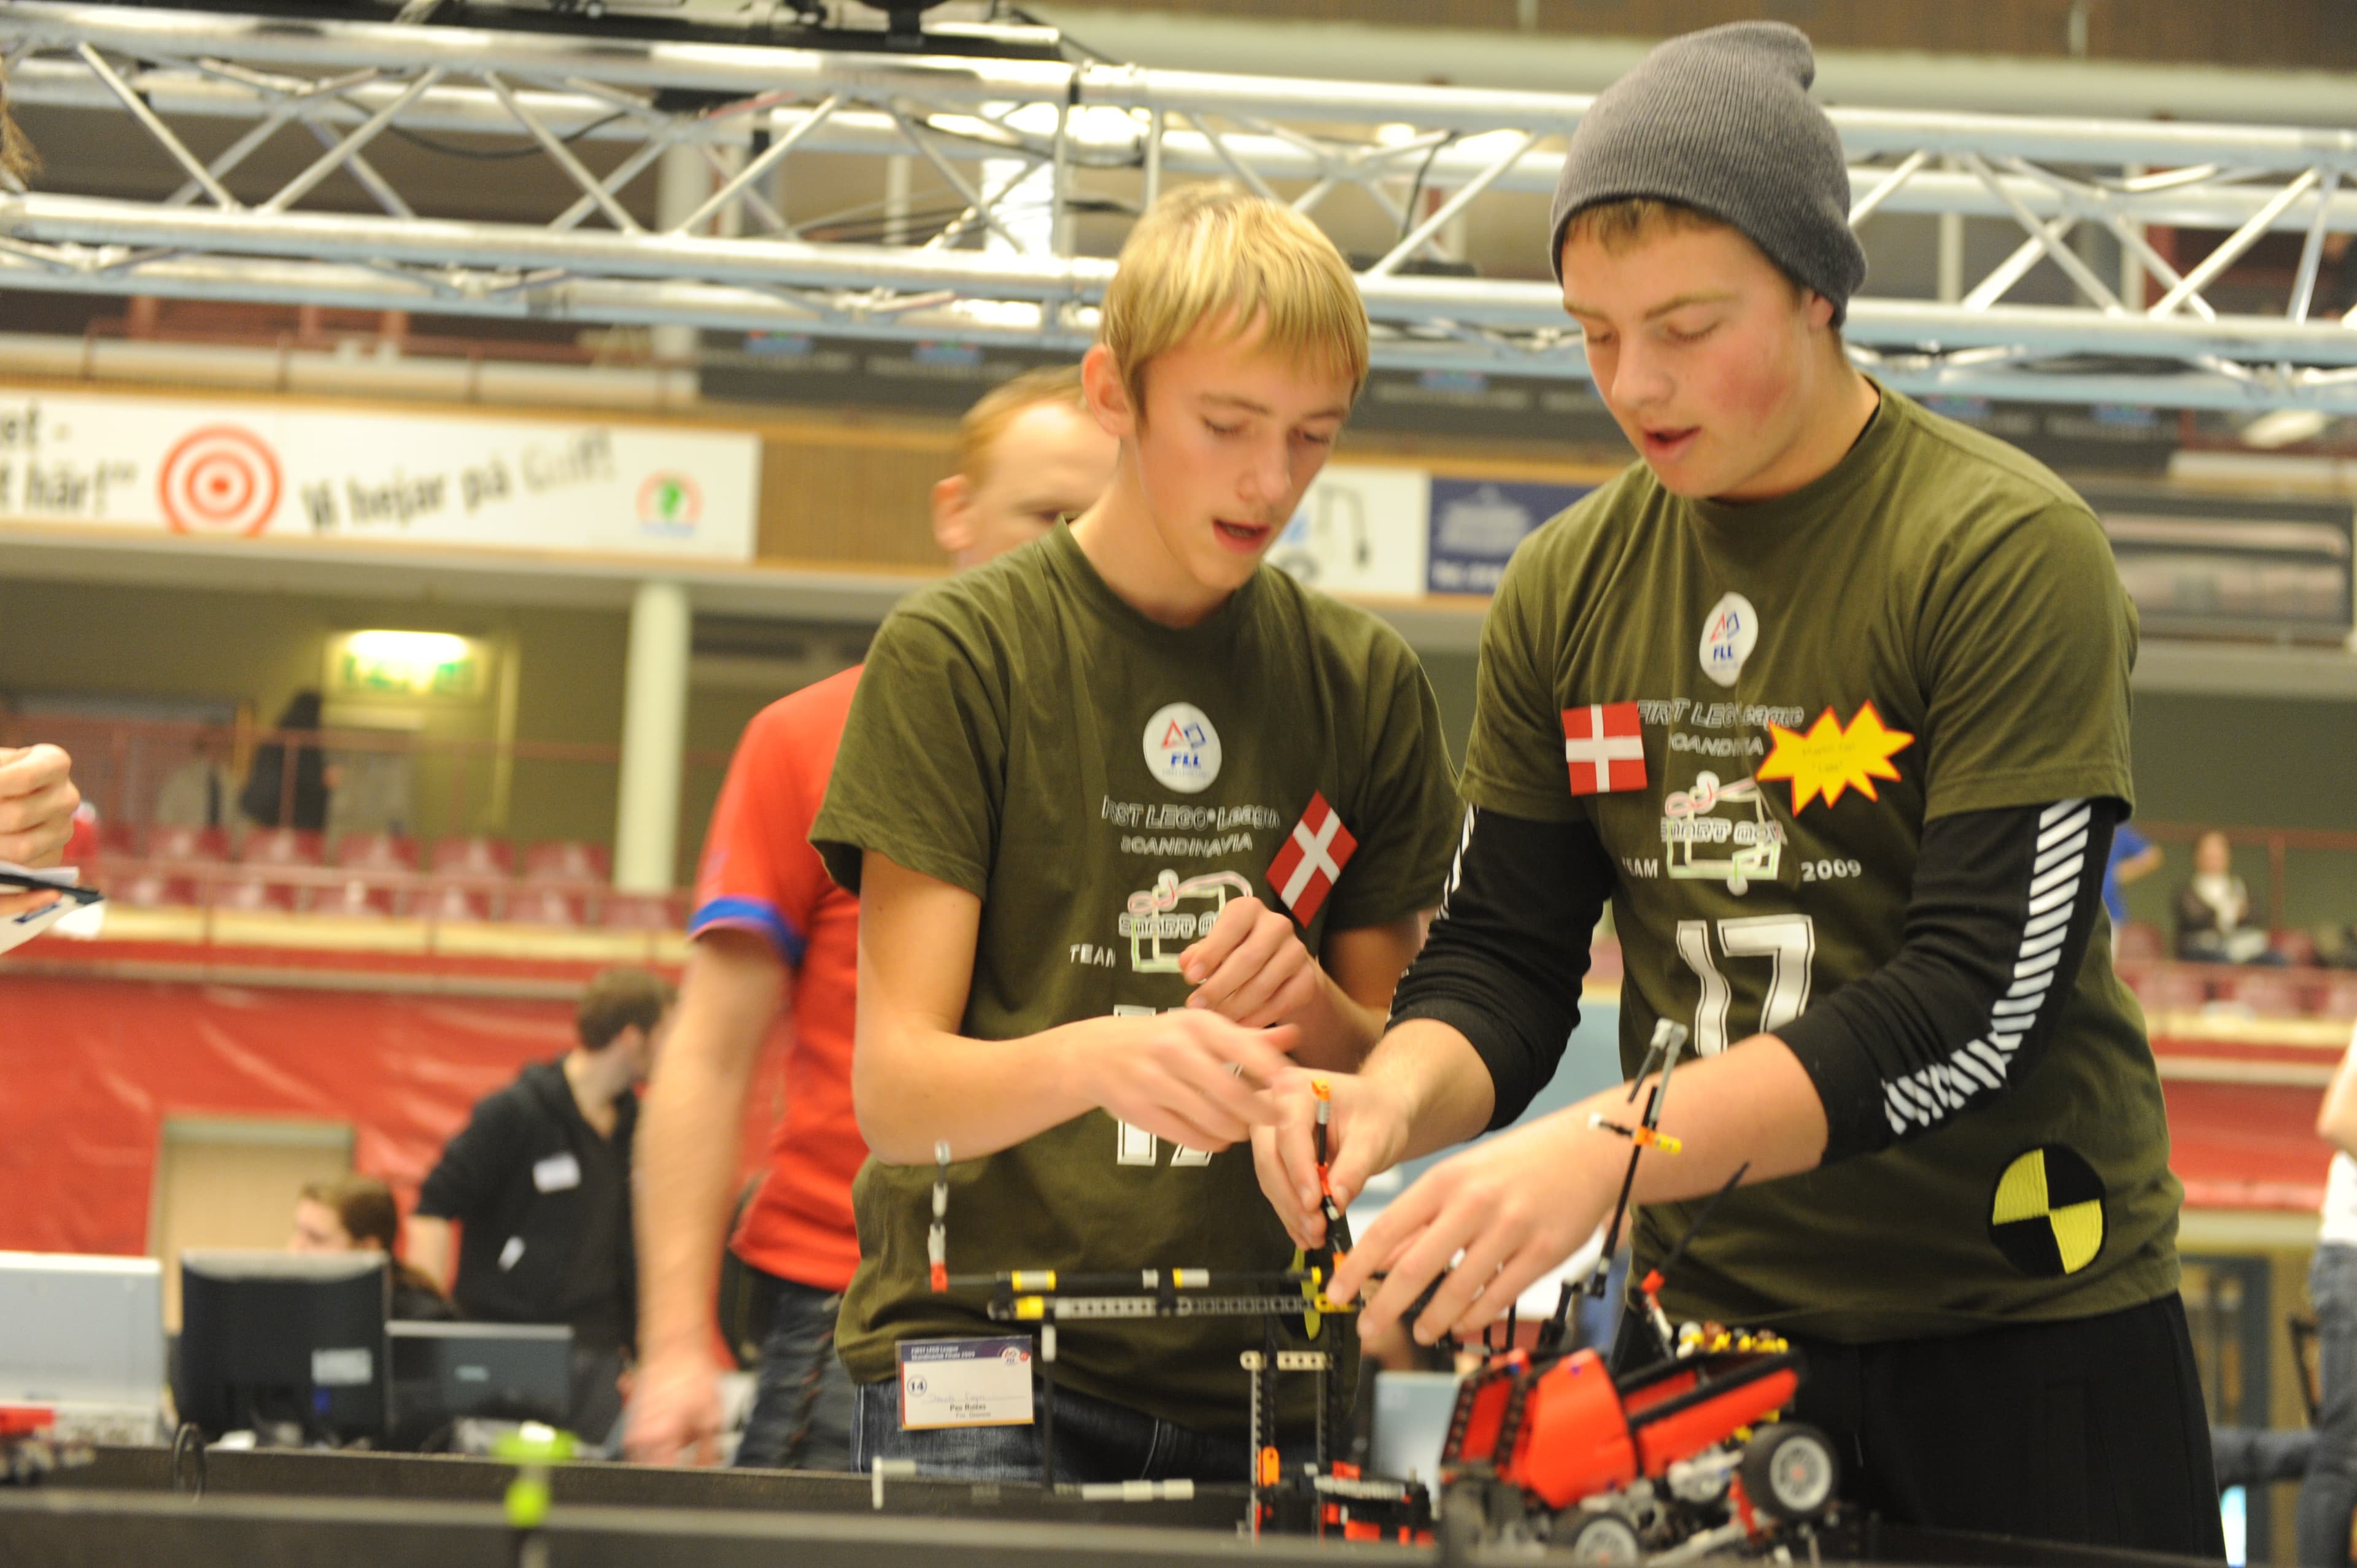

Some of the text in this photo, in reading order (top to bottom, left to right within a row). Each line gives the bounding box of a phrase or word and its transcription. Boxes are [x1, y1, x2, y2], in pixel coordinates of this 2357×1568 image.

[1713, 644, 1733, 661] FLL
[1171, 752, 1201, 768] FLL
[1800, 860, 1862, 882] 2009
[1676, 913, 1816, 1060] 17
[910, 1381, 924, 1391] 14
